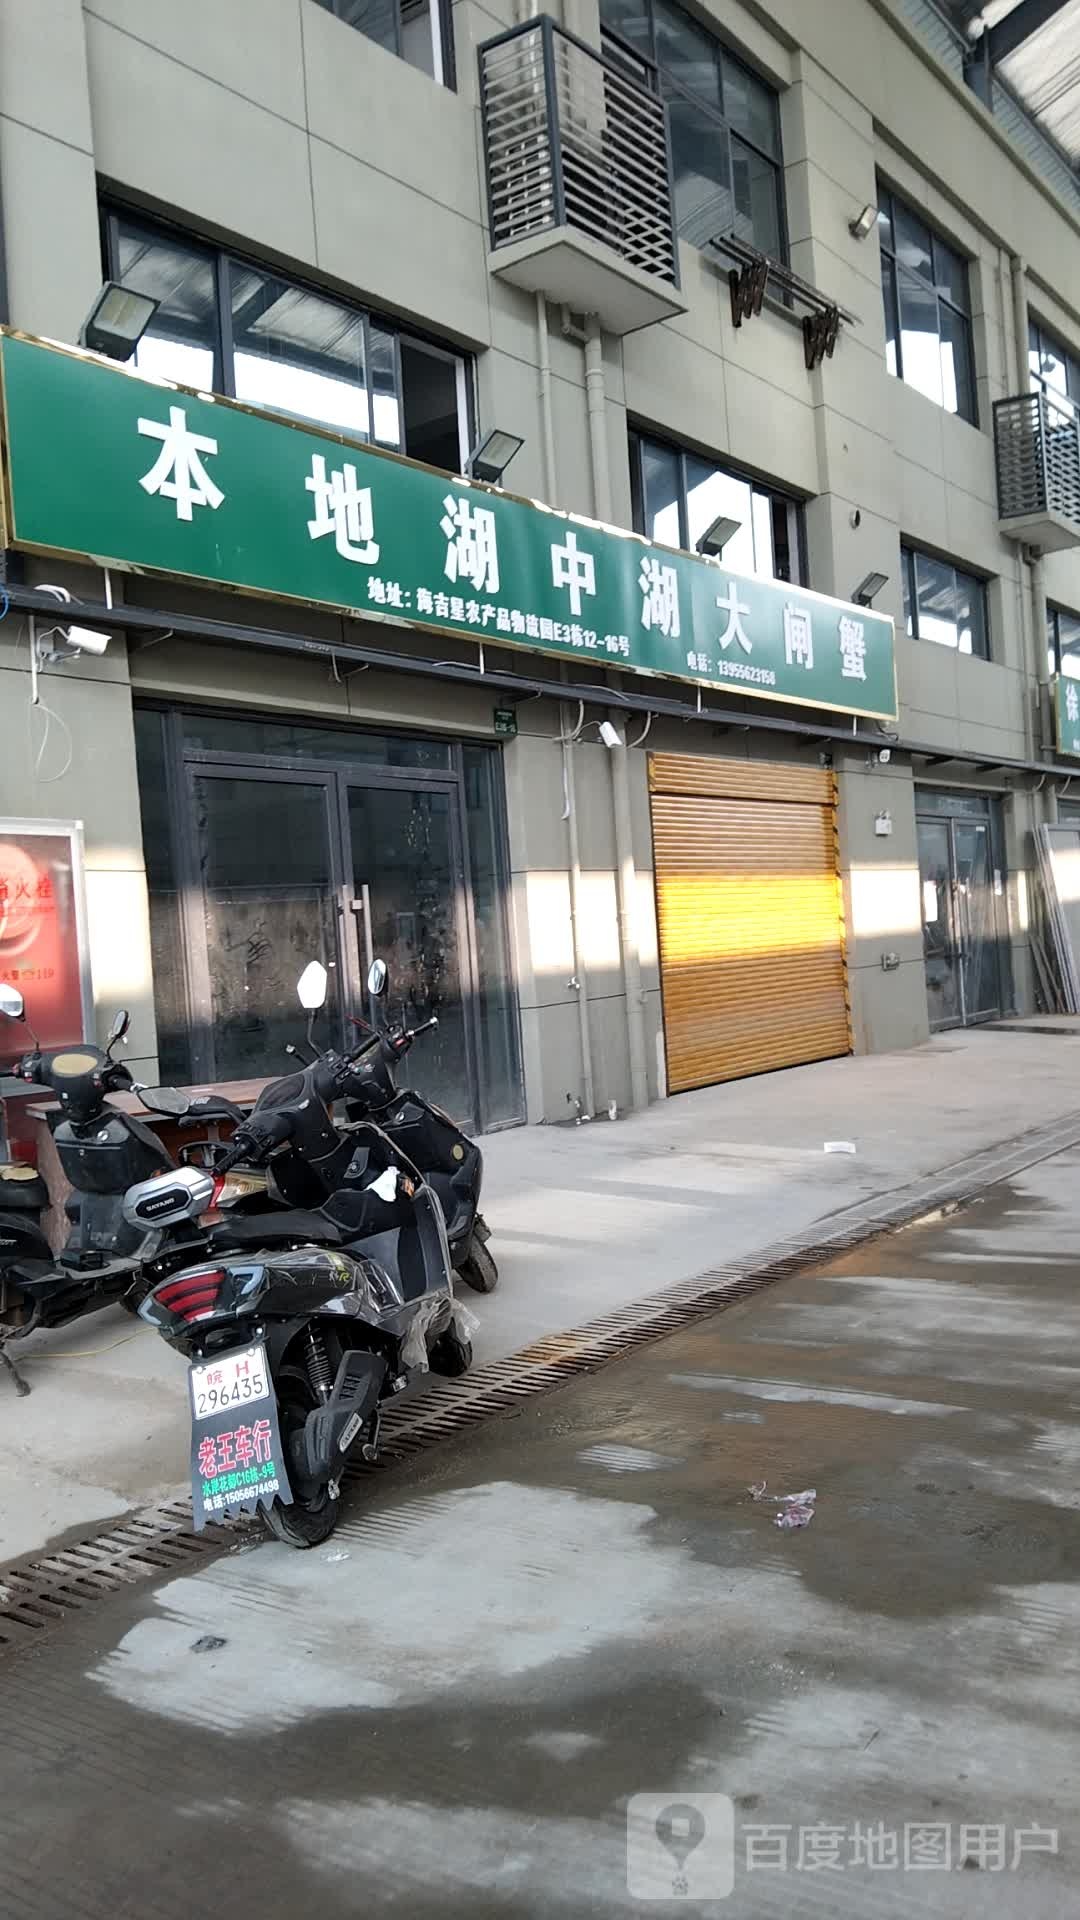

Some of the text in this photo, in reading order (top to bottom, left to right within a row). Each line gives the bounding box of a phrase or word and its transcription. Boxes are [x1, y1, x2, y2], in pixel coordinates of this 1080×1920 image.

[137, 405, 868, 682] 本地湖中湖大闸蟹
[198, 1374, 263, 1414] 296435
[198, 1420, 272, 1478] 老王车行
